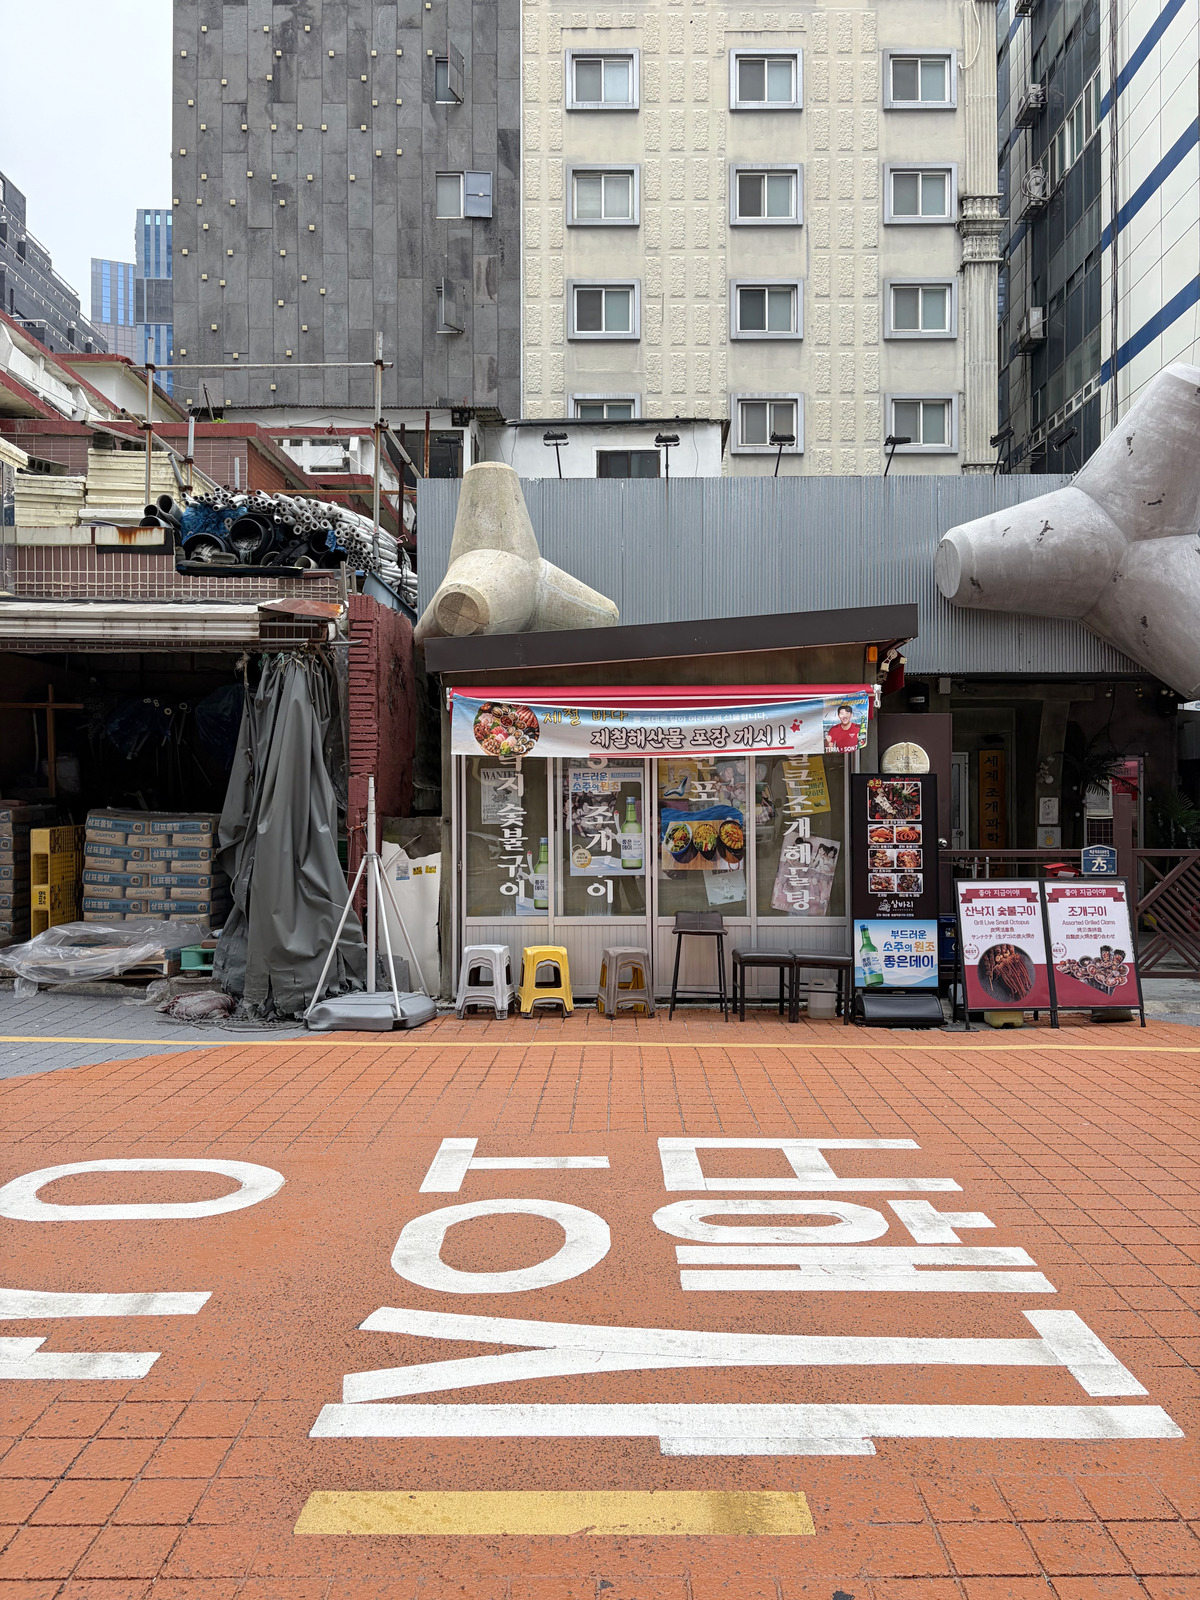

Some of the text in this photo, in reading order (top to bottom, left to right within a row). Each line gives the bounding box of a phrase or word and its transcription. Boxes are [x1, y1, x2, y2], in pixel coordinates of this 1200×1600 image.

[590, 727, 686, 750] 제철해산물
[690, 726, 729, 748] 포장
[733, 725, 773, 747] 개시
[573, 772, 608, 782] 부드러운
[572, 782, 620, 792] 소주의 원조
[1091, 860, 1107, 871] 25
[965, 905, 1036, 917] 산낙지 숯불구이
[1068, 906, 1107, 917] 조개구이
[890, 930, 927, 940] 부드러운
[882, 941, 935, 952] 소주의 원조
[883, 955, 934, 968] 좋은데이
